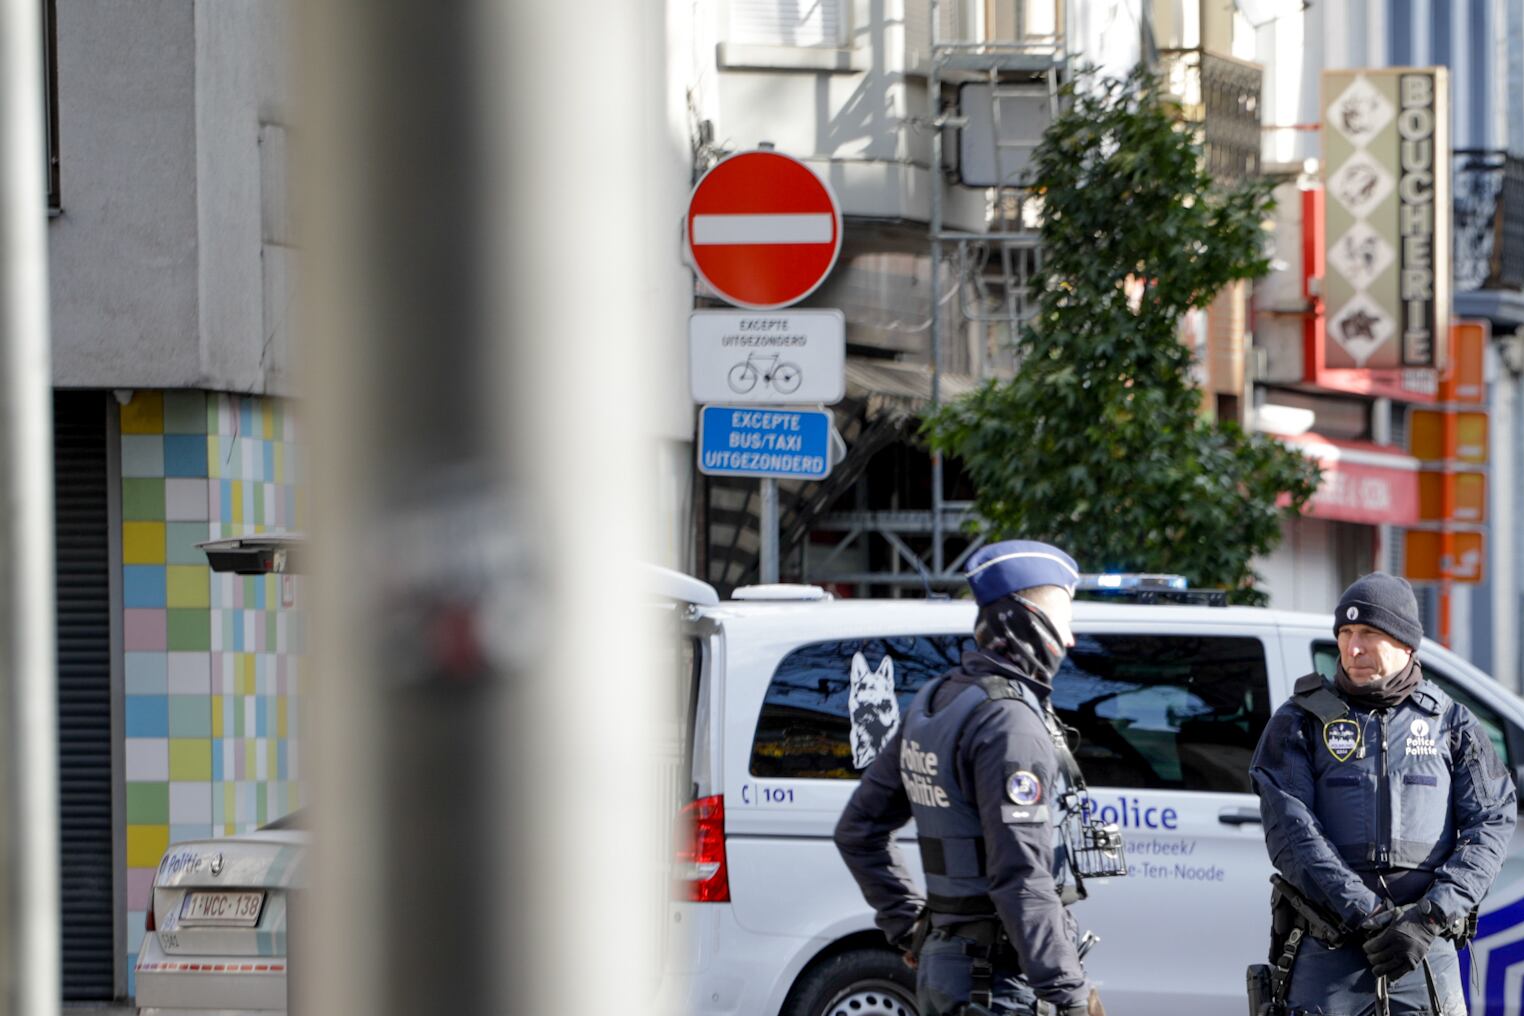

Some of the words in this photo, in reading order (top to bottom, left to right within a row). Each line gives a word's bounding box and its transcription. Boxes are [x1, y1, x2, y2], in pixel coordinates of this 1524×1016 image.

[1400, 74, 1434, 364] BOUCHERIE
[739, 319, 789, 331] EXCEPTE
[721, 334, 807, 347] UITGEZONDERD
[731, 411, 801, 430] EXCEPTE
[729, 431, 802, 451] BUS/TAXI
[704, 450, 824, 474] UITGEZONDERD
[1405, 746, 1438, 756] Politie
[1406, 738, 1435, 747] Police
[763, 788, 794, 803] 101
[1081, 797, 1178, 830] Police
[168, 852, 203, 873] Politie
